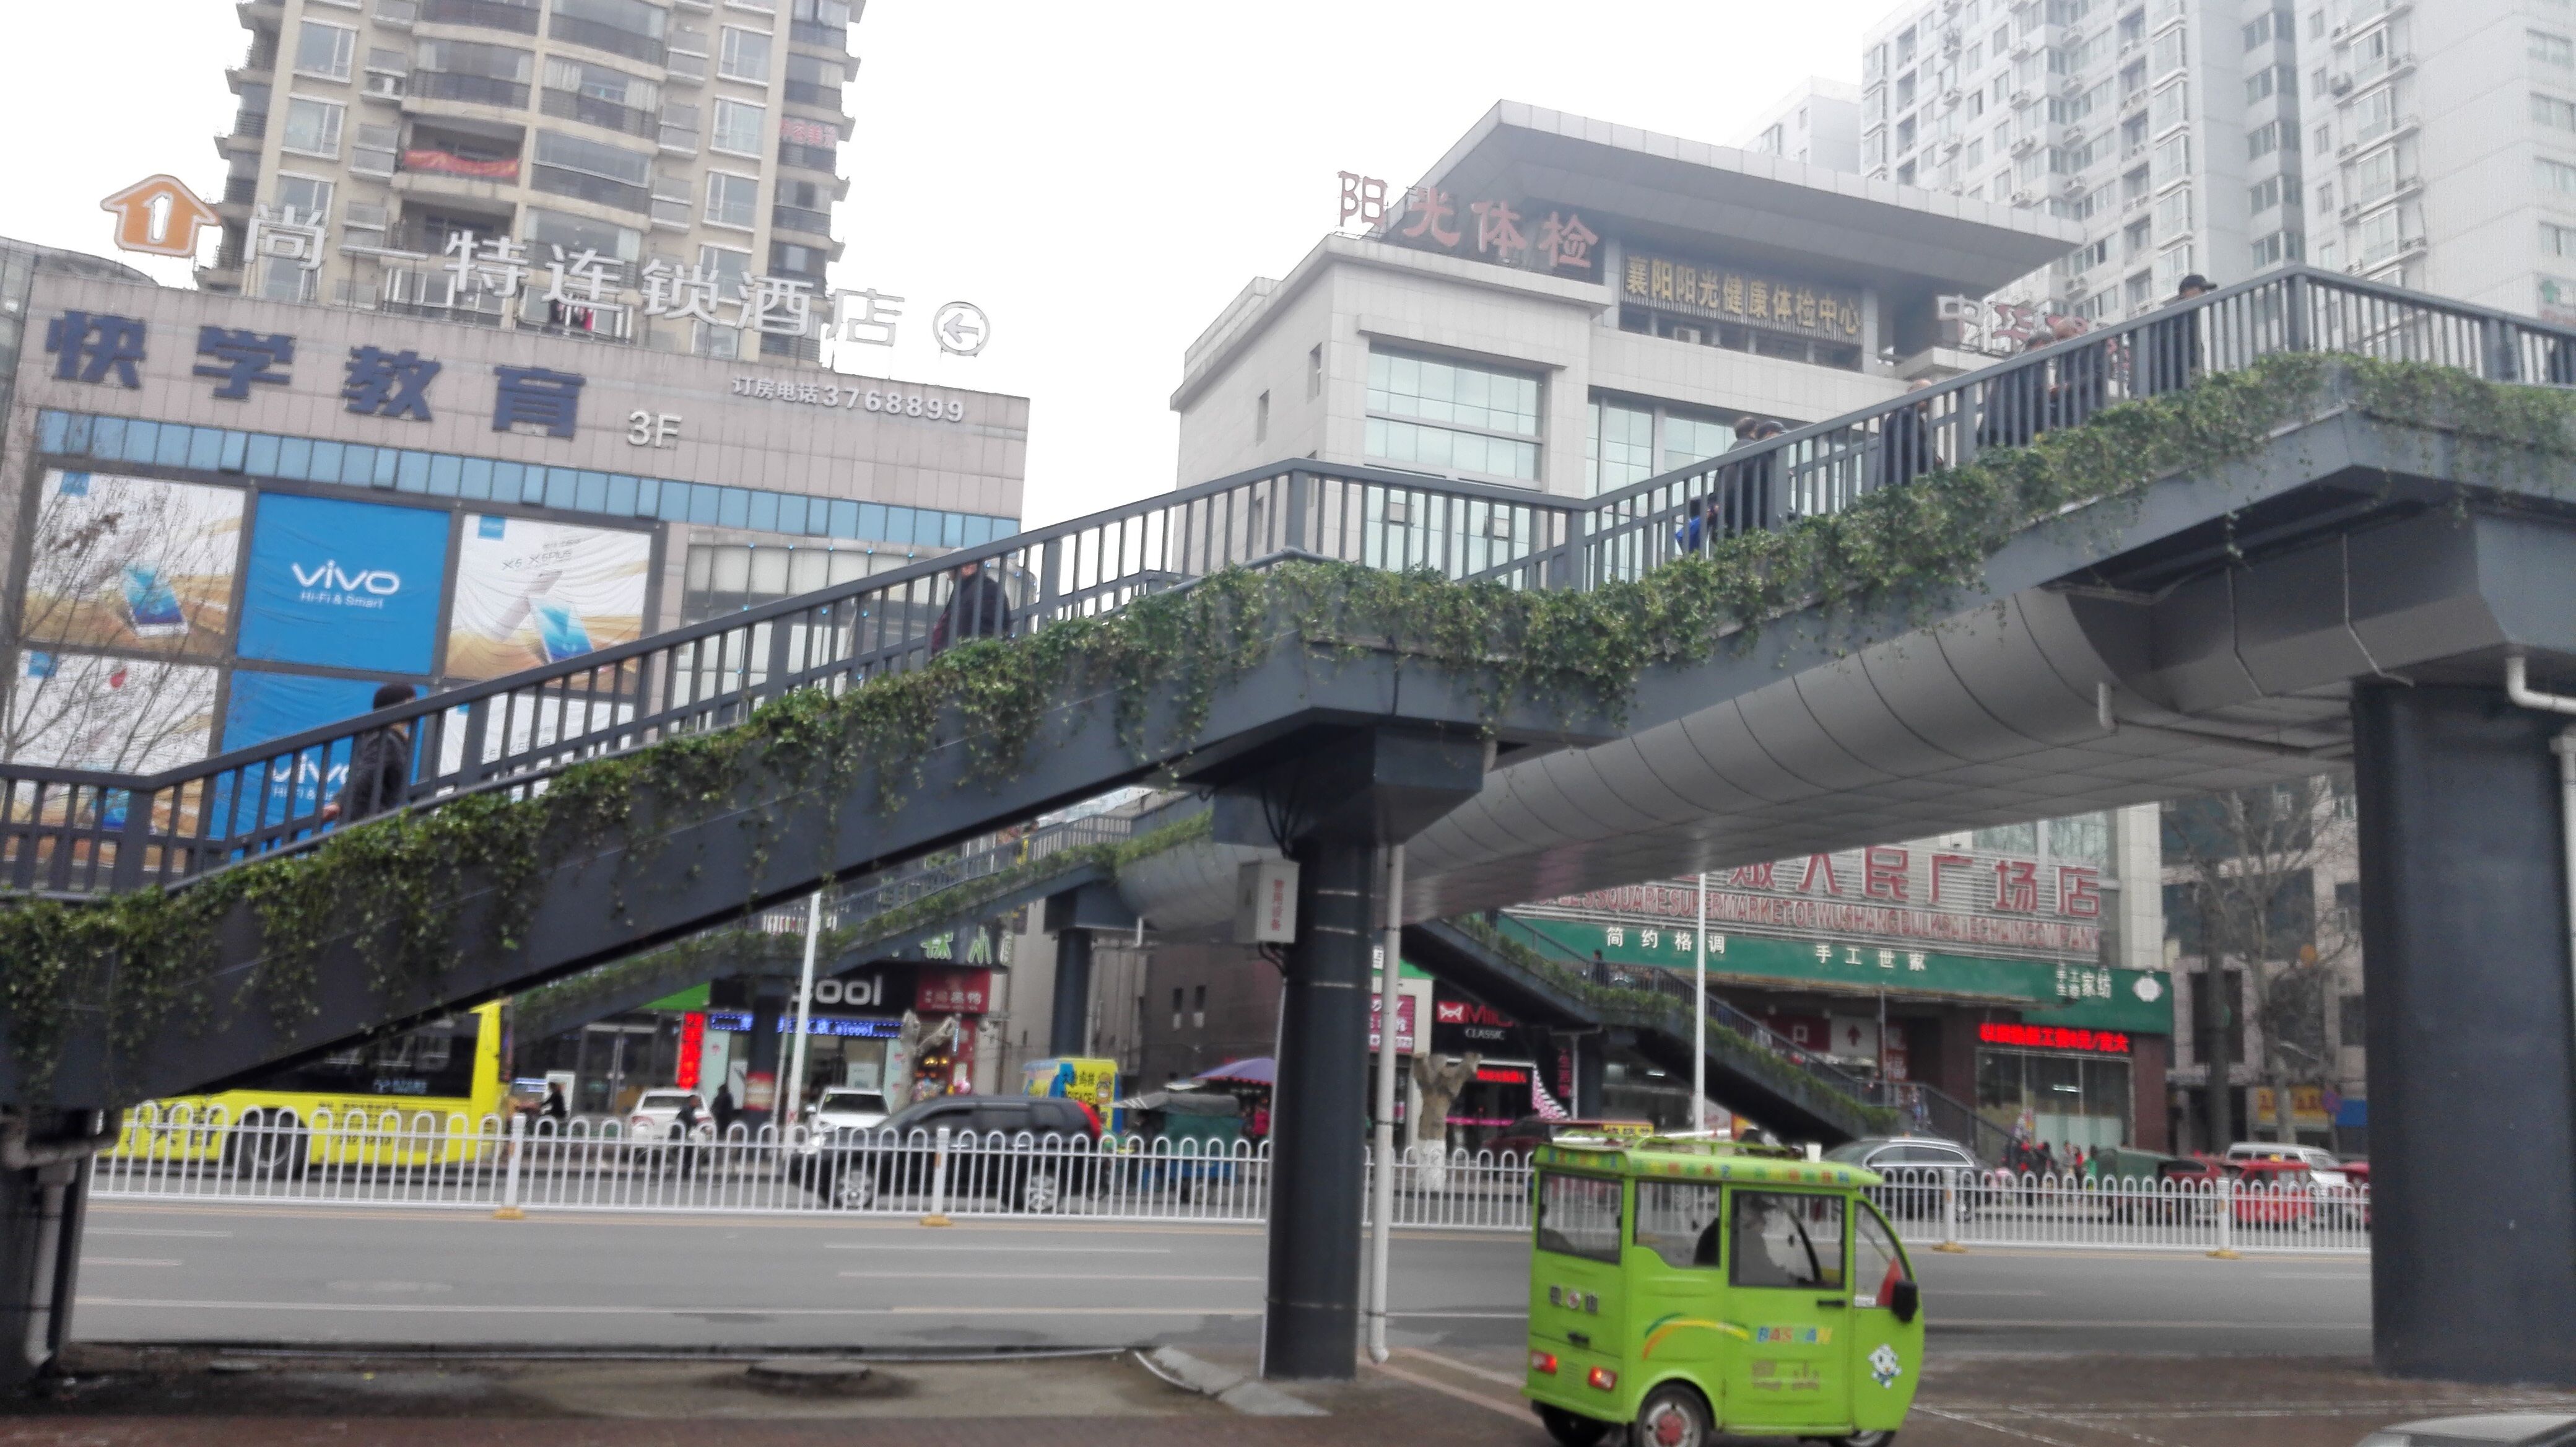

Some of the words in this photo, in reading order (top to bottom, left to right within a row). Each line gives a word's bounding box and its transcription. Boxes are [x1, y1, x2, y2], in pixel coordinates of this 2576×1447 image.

[1338, 170, 1599, 268] 阳光体检
[243, 204, 905, 347] 尚一特连锁酒店
[1626, 254, 1858, 335] 襄阳阳光健康体检中心
[45, 310, 586, 440] 快学教育
[627, 409, 682, 450] 3F
[290, 559, 401, 595] vivo
[300, 589, 330, 604] Hi-Fi
[344, 595, 384, 610] Smart
[1595, 886, 1666, 914] SQUARE
[1669, 889, 1790, 925] SUPERMARKET
[1606, 927, 1725, 955] 简约格调
[1815, 944, 1926, 971] 手工世家
